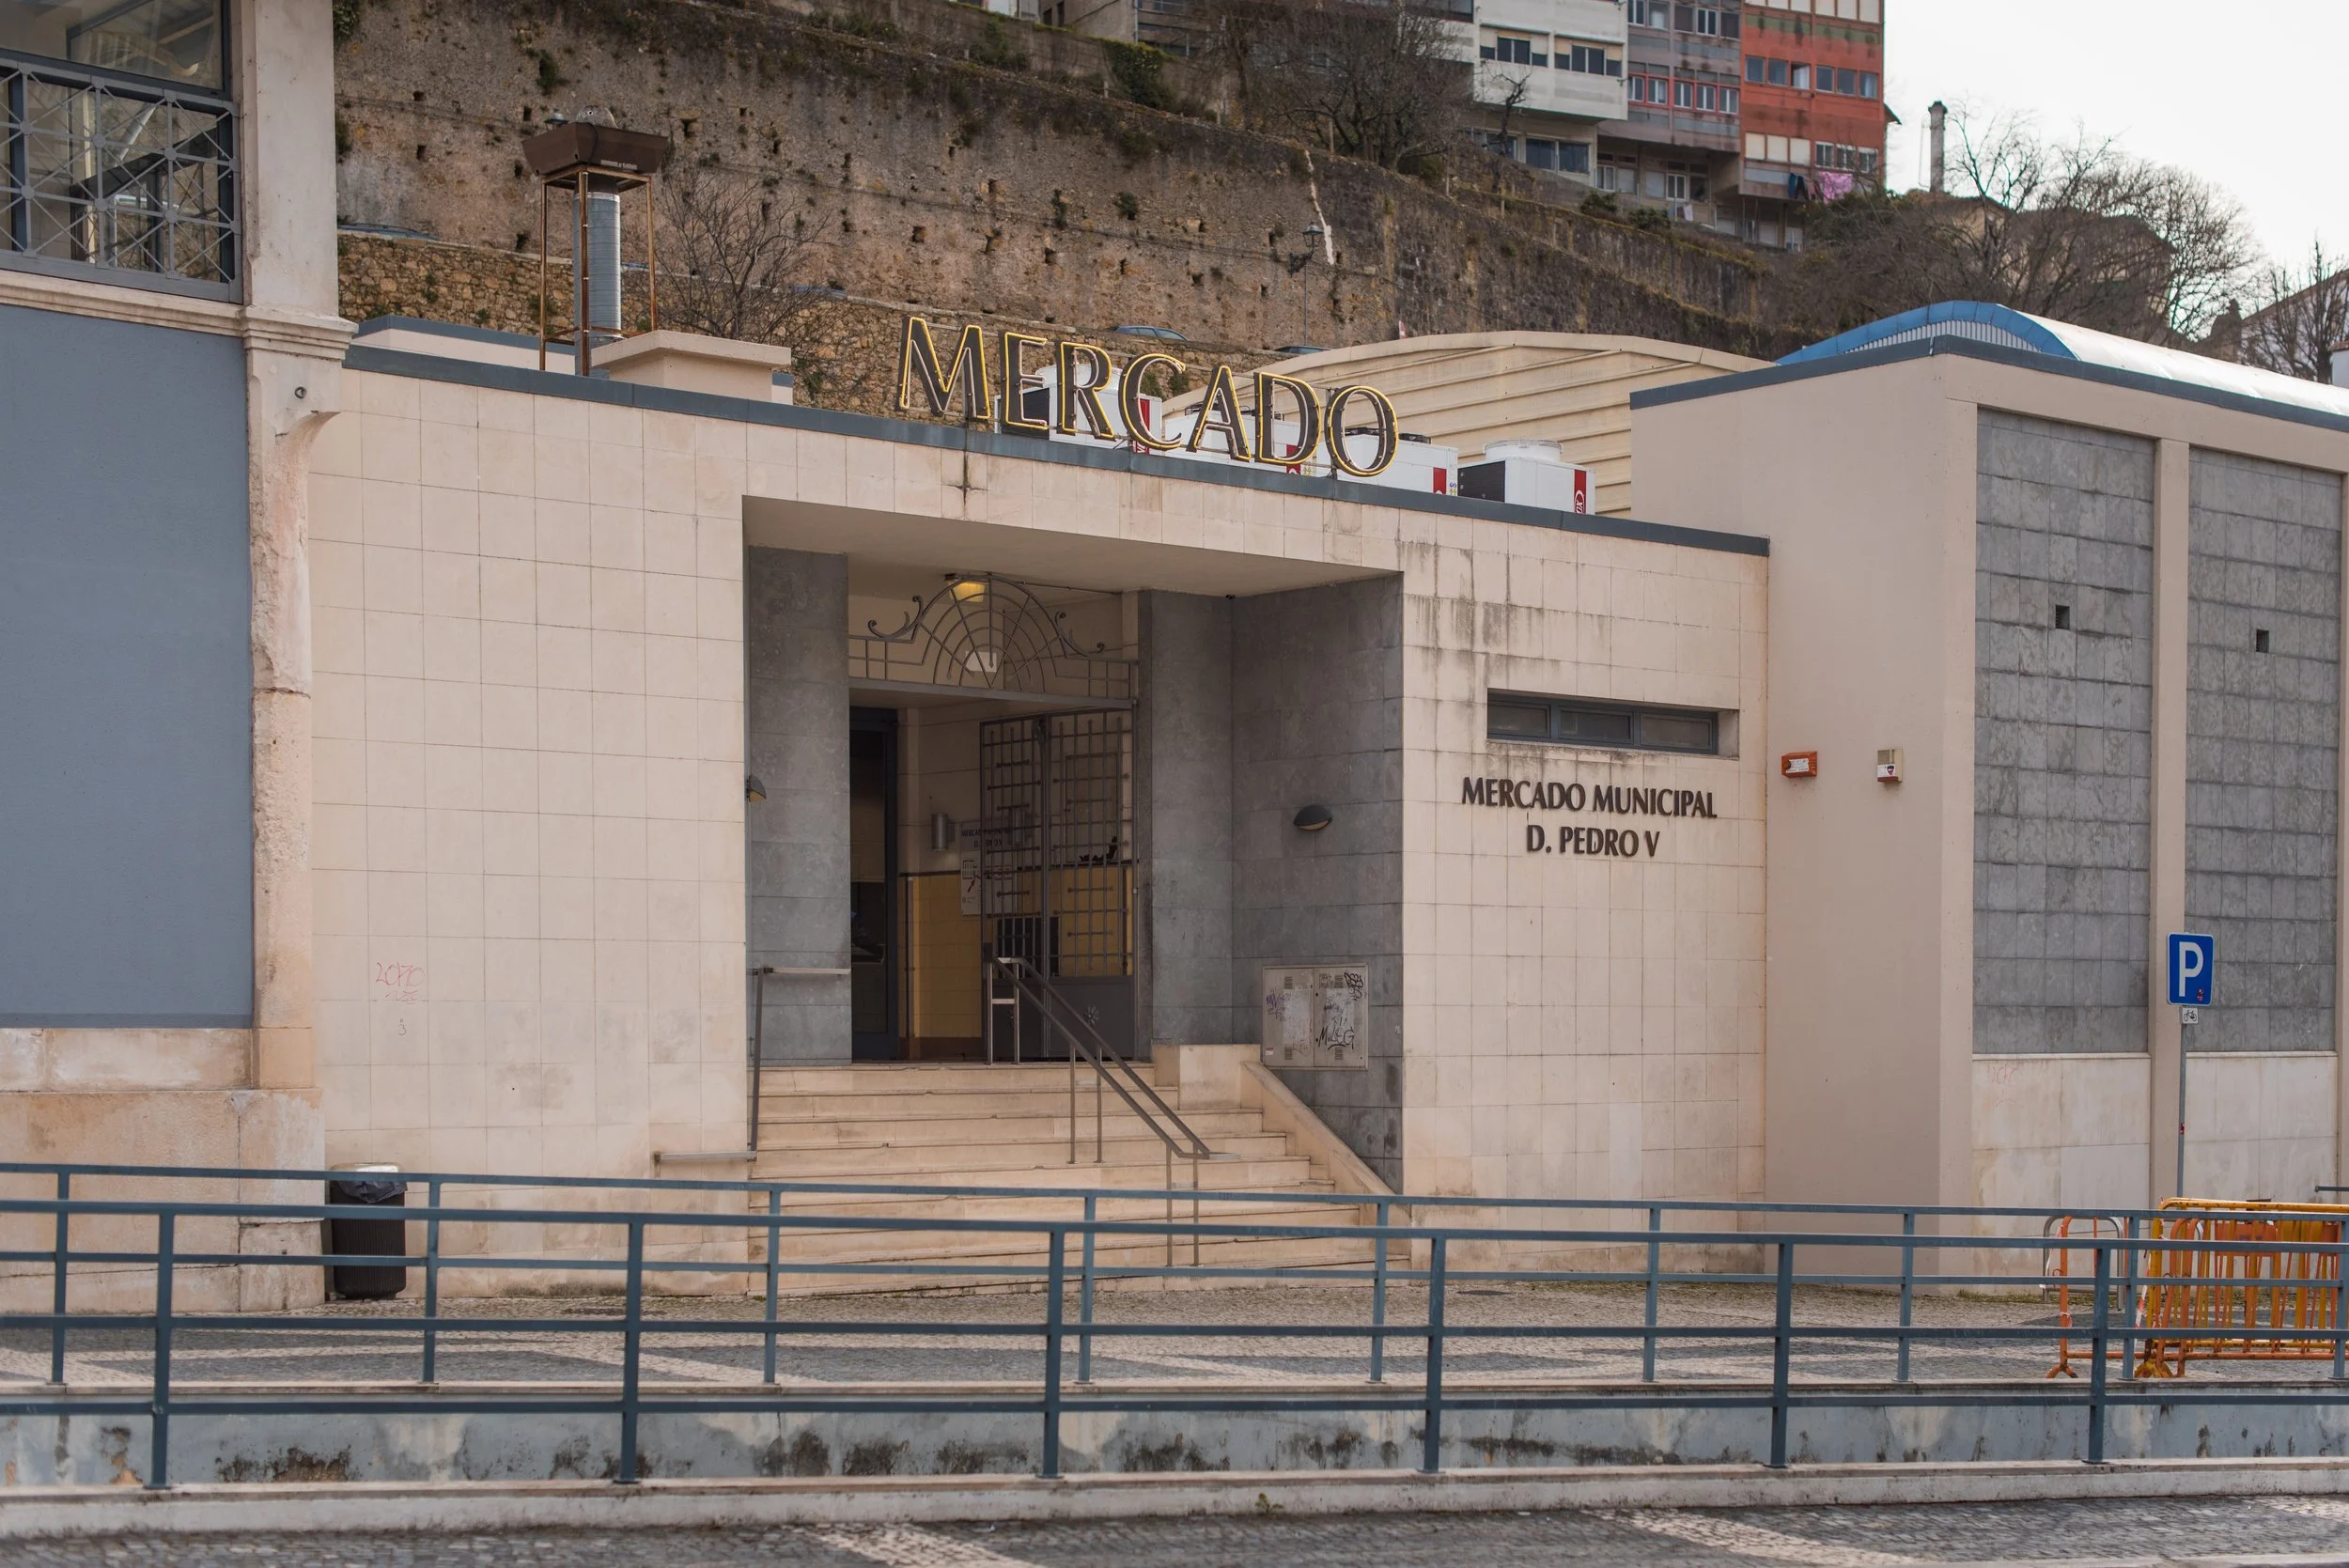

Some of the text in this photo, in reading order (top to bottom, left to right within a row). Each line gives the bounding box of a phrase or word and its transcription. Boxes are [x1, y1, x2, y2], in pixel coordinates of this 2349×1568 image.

[894, 316, 1399, 476] MERCADO
[1461, 777, 1718, 818] MERCADO MUNICIPAL
[1526, 824, 1660, 857] D. PEDRO V
[2178, 941, 2204, 998] P
